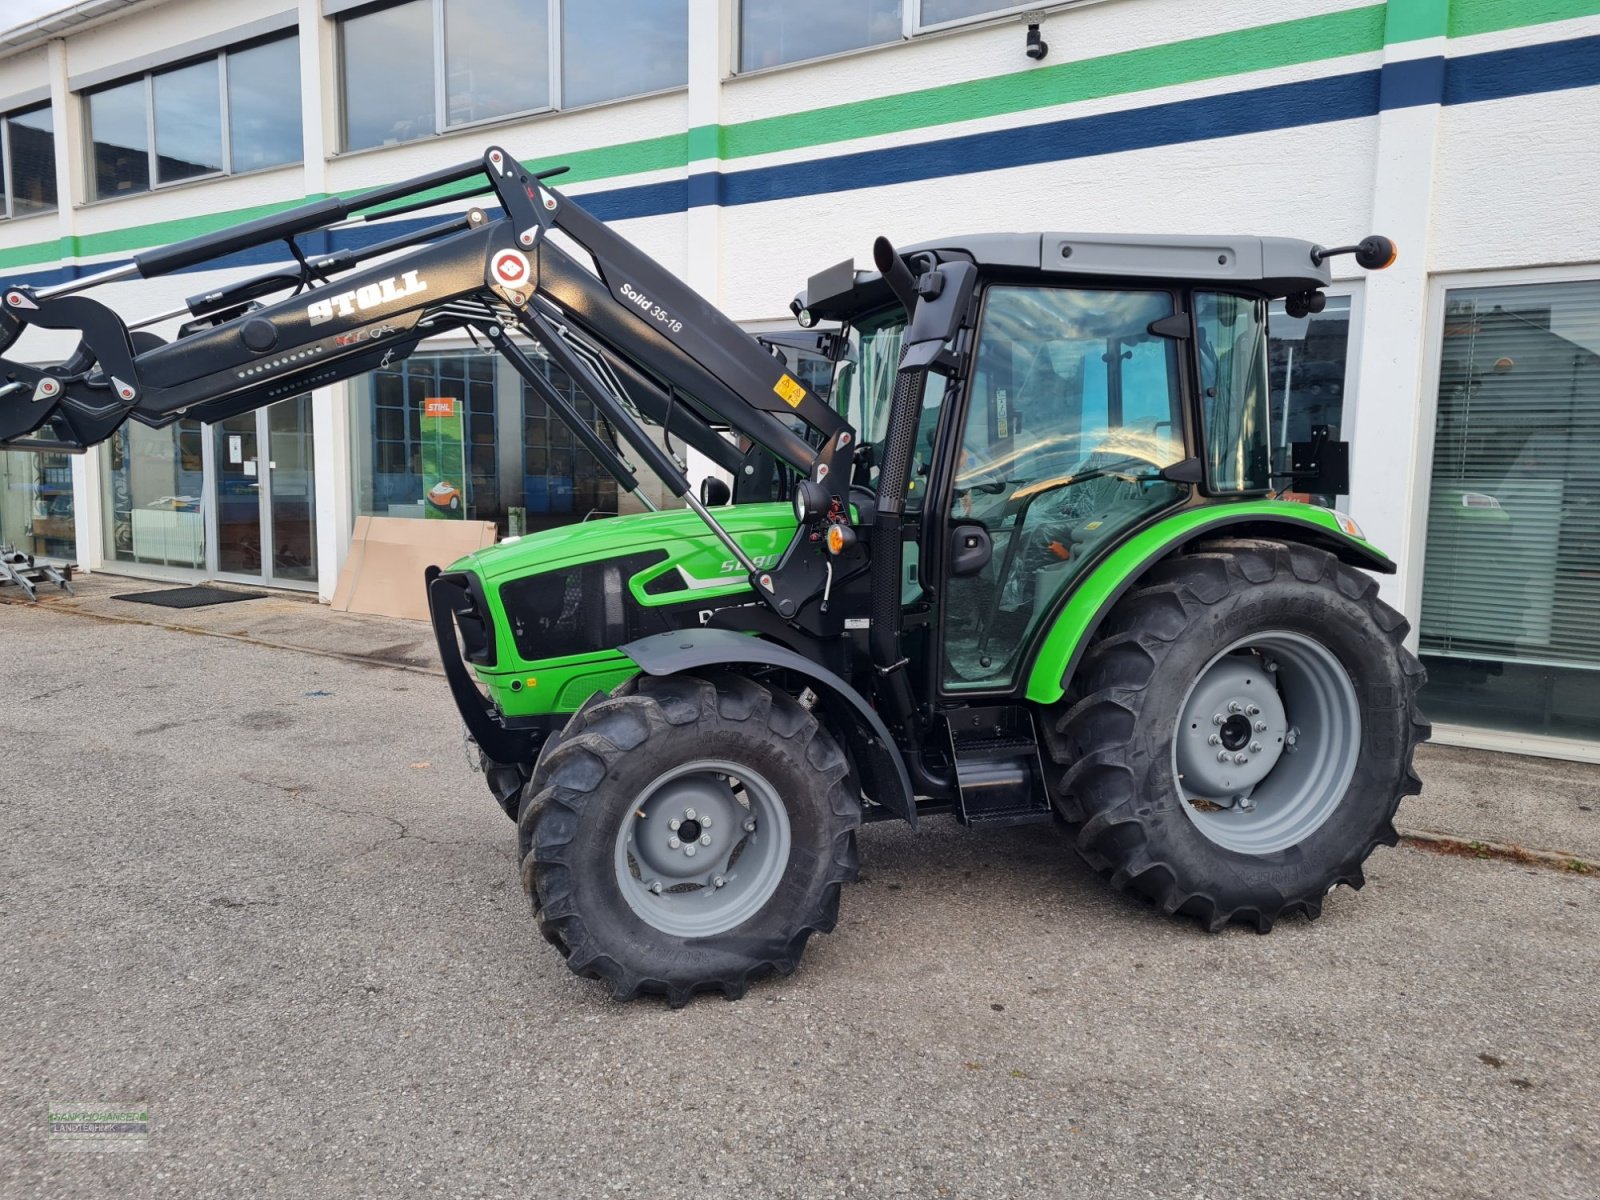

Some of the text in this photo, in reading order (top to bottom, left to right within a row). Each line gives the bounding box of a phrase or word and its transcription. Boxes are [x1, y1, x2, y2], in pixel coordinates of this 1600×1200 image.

[307, 269, 428, 327] STOLL
[620, 283, 683, 333] Solid 35-18
[428, 403, 451, 412] STIHL
